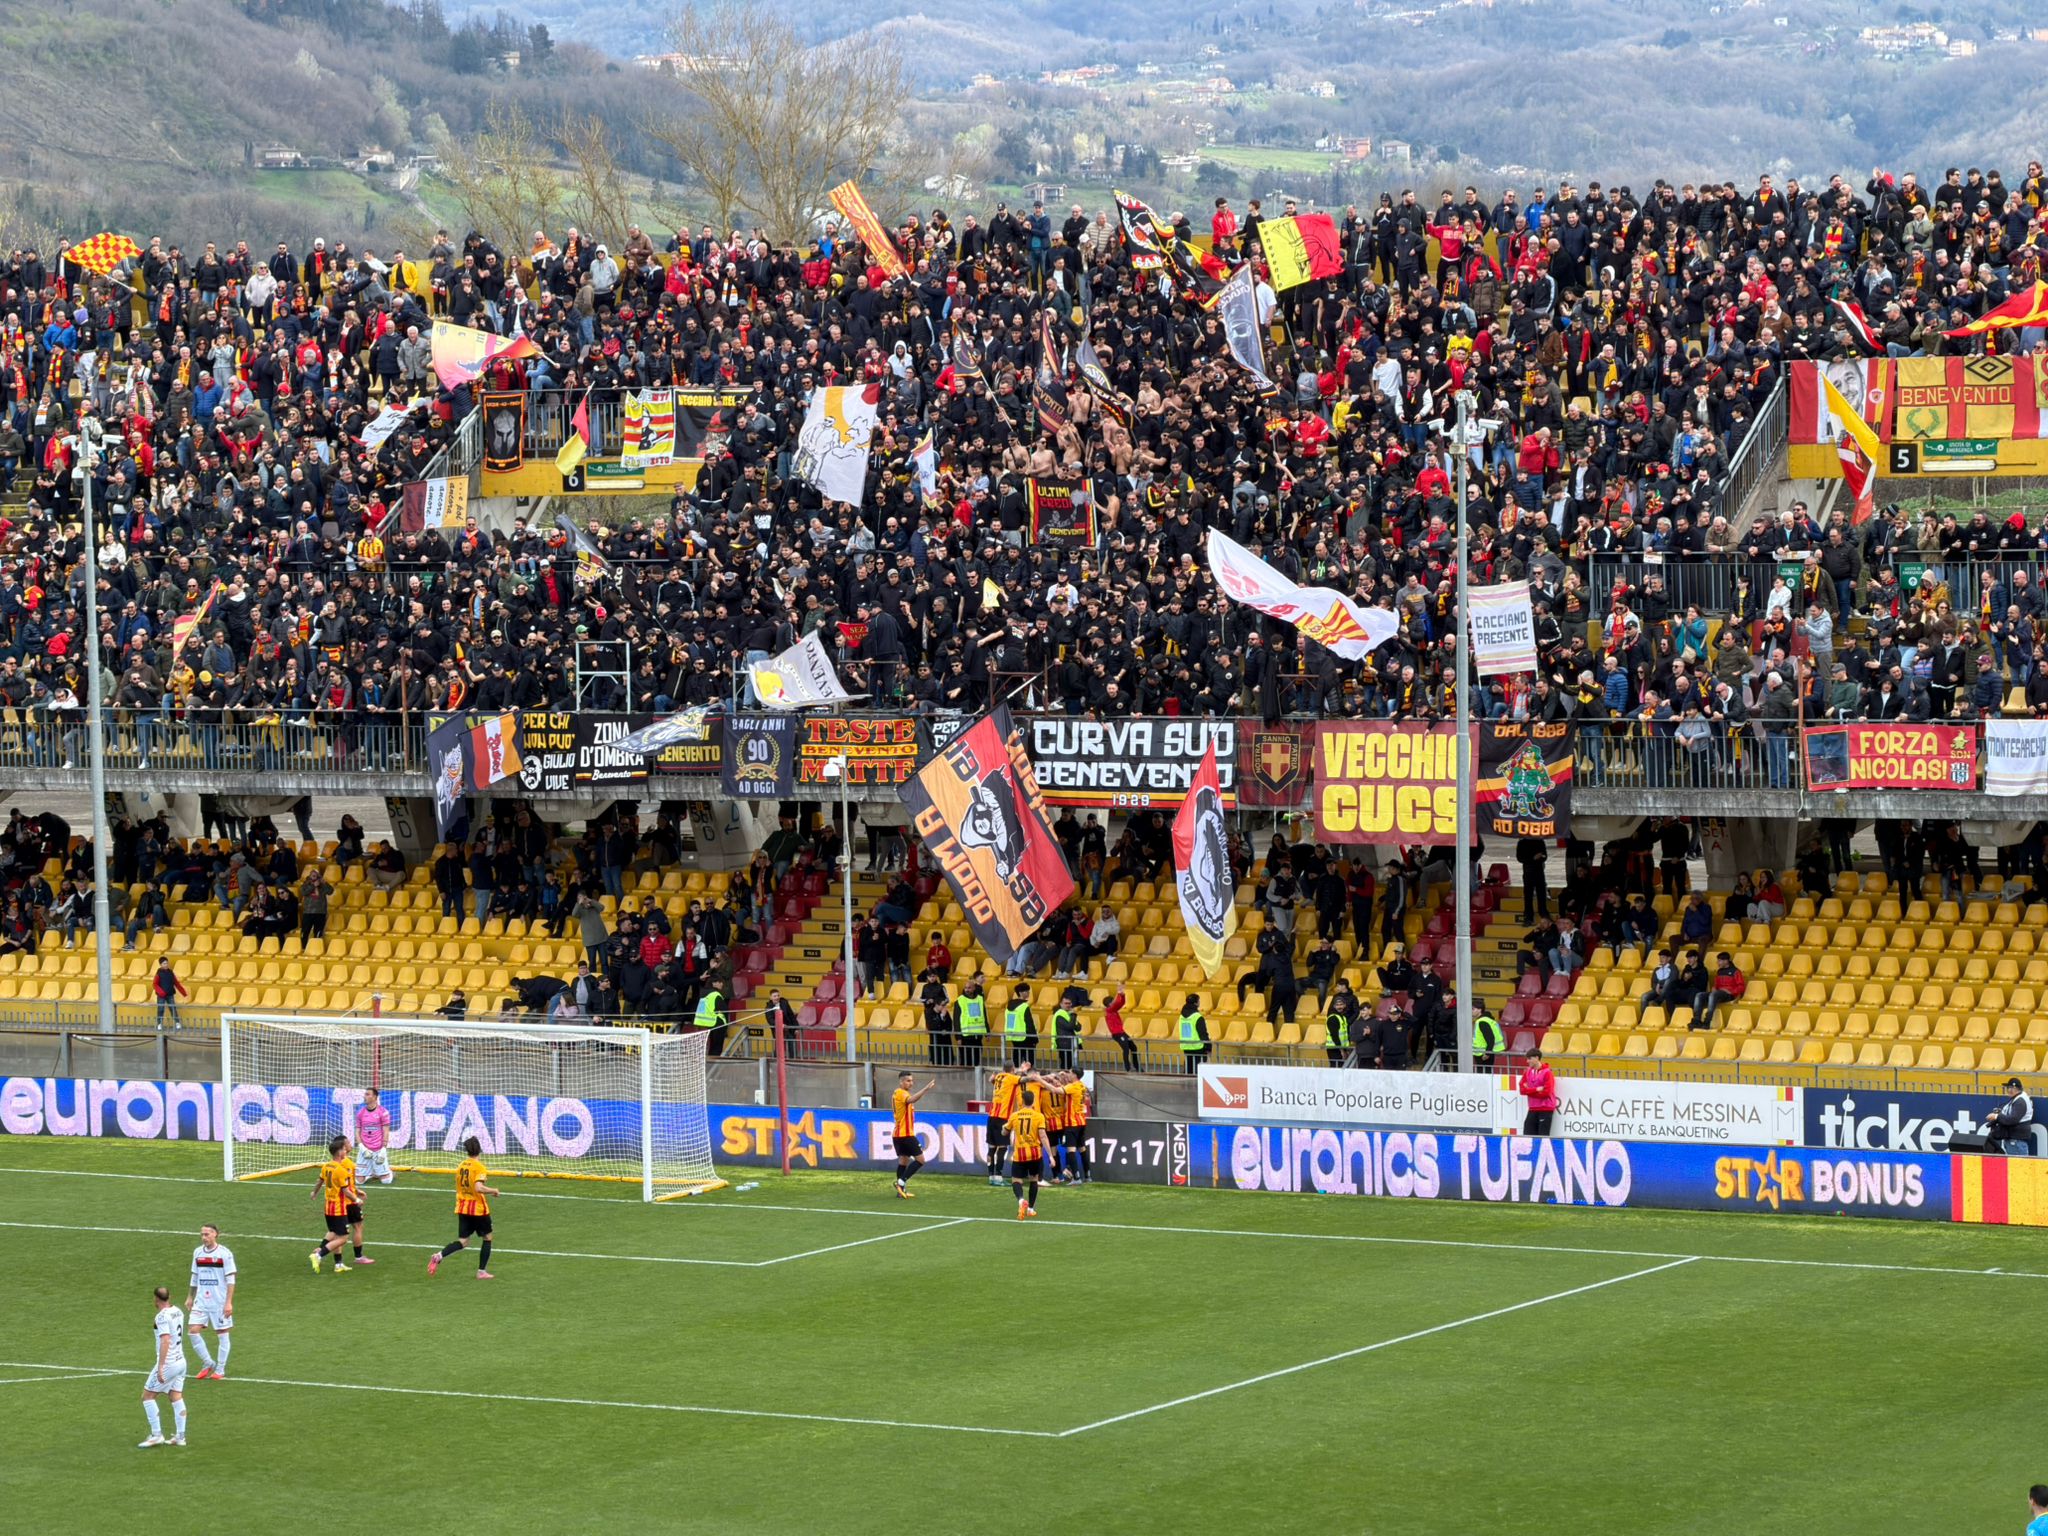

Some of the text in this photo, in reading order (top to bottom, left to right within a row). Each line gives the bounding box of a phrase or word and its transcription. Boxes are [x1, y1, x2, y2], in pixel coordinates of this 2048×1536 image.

[678, 395, 712, 406] VECCHIO
[1901, 386, 2011, 405] BENEVENTO
[1896, 449, 1910, 468] 5
[568, 471, 579, 487] 6
[1475, 611, 1527, 629] CACCIANO
[1477, 628, 1529, 645] PRESENTE
[523, 713, 546, 729] PER
[549, 713, 569, 729] CHI
[761, 718, 786, 731] ANNI
[594, 722, 630, 745] ZONA
[804, 718, 915, 744] TESTE
[1033, 721, 1235, 757] CURVA SUD
[1262, 735, 1291, 743] SANNIO
[1494, 724, 1528, 738] DAL
[747, 738, 769, 761] 90
[805, 745, 916, 755] BENEVENTO
[1859, 731, 1938, 755] FORZA
[543, 753, 575, 769] GIULIO
[580, 746, 645, 767] D'OMBRA
[1322, 732, 1472, 780] VECCHIO
[591, 769, 632, 781] Benevento
[1850, 757, 1947, 780] NICOLAS!
[545, 774, 569, 790] VIVE
[738, 781, 775, 793] AD OGGI
[1112, 793, 1150, 806] 1929
[1322, 784, 1457, 834] CUCS
[1493, 820, 1555, 836] AD OGGI
[1260, 1087, 1488, 1116] Banca Popolare Pugliese
[1600, 1095, 1665, 1120] CAFFÈ
[1673, 1103, 1762, 1125] MESSINA
[333, 1087, 595, 1158] TUFANO
[1564, 1121, 1729, 1139] HOSPITALITY & BANQUETING
[1085, 1136, 1165, 1165] 17:17
[1172, 1124, 1186, 1167] NGM
[1231, 1126, 1632, 1206] euronics TUFANO
[459, 1168, 470, 1188] 23
[1812, 1160, 1924, 1207] BONUS
